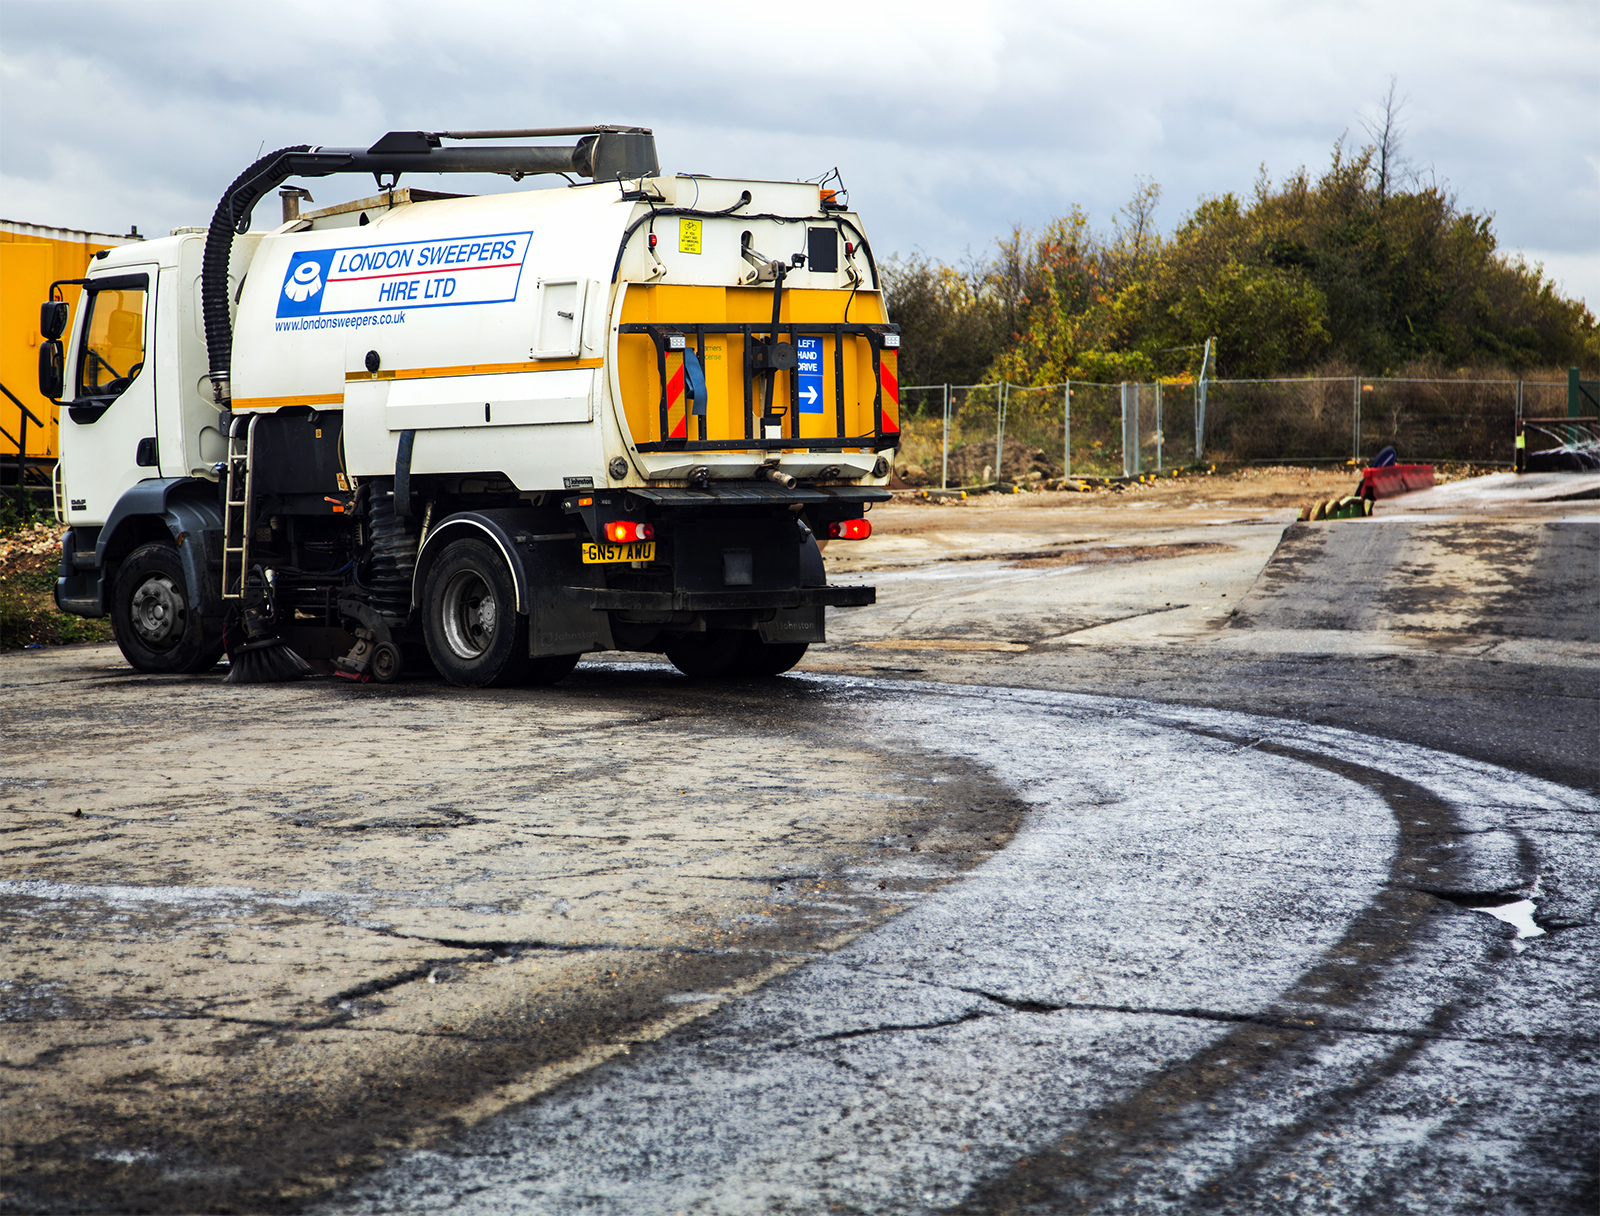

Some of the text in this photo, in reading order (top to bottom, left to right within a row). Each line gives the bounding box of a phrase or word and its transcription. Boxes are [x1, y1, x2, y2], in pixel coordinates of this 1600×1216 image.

[338, 240, 517, 273] LONDON SWEEPERS
[378, 278, 456, 302] HIRE LTD
[275, 311, 406, 332] www.londonsweepers.co.uk
[798, 339, 815, 348] LEFT
[797, 351, 817, 360] HAND
[588, 544, 651, 560] GN57 AWU
[780, 621, 815, 630] Johnston
[554, 631, 599, 641] Johnston
